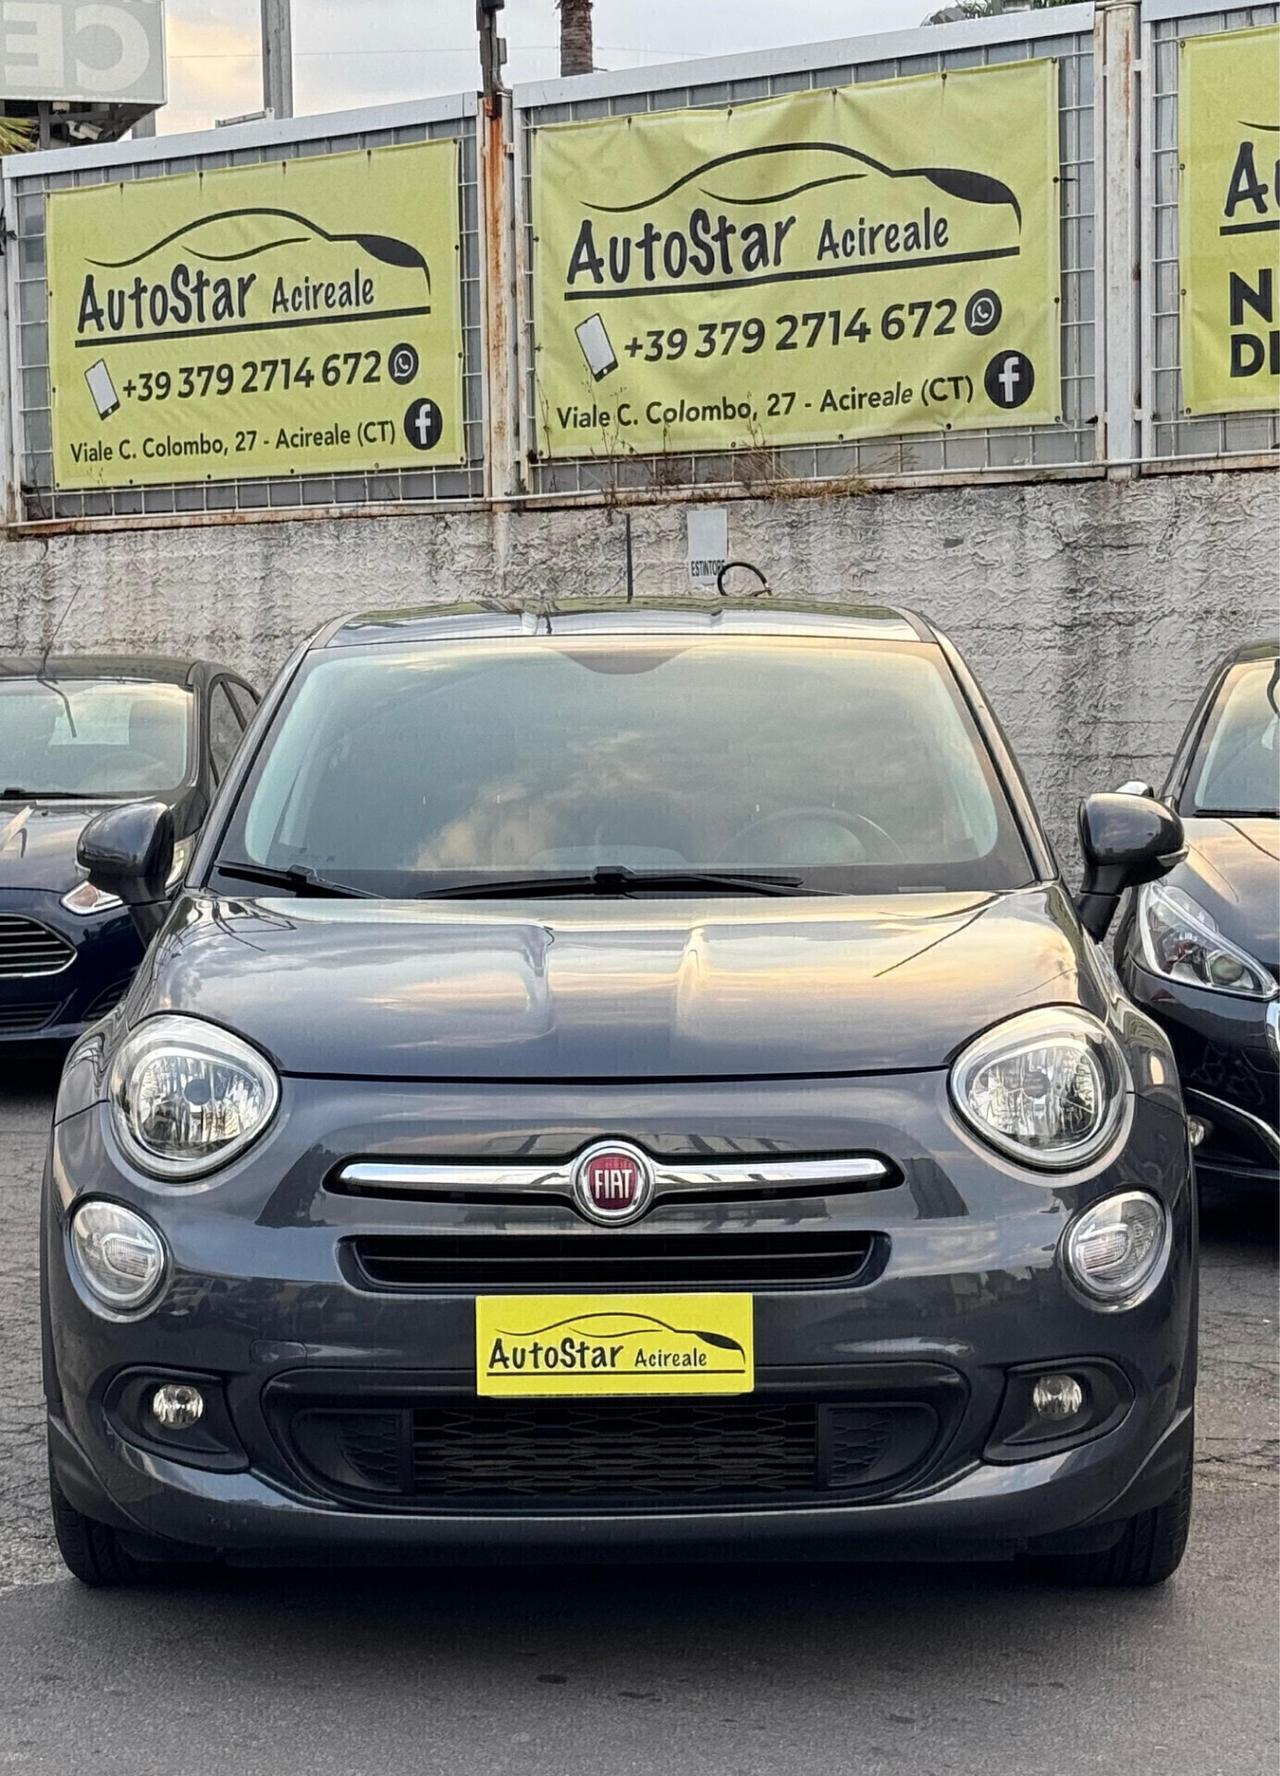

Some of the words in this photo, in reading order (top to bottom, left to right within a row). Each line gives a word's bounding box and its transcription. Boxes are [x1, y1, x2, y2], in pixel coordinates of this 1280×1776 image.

[1224, 141, 1280, 217] A
[566, 208, 797, 284] AutoStar
[816, 207, 950, 261] Acireale
[77, 263, 257, 334] AutoStar
[271, 268, 375, 314] Acireale
[624, 328, 688, 362] +39
[694, 317, 766, 358] 379
[774, 306, 871, 352] 2714
[880, 297, 957, 341] 672
[122, 371, 172, 402] +39
[177, 366, 235, 398] 379
[240, 356, 316, 394] 2714
[322, 350, 382, 387] 672
[556, 402, 611, 430] Viale
[616, 405, 640, 427] C.
[645, 396, 759, 427] Colombo,
[766, 393, 796, 415] 27
[820, 382, 914, 412] Acireale
[920, 375, 974, 407] (CT)
[70, 440, 114, 464] Viale
[118, 442, 138, 461] C.
[142, 434, 229, 459] Colombo,
[234, 430, 258, 453] 27
[275, 423, 352, 450] Acireale
[357, 419, 397, 447] (CT)
[594, 1169, 633, 1200] FIAT
[488, 1337, 625, 1369] AutoStar
[634, 1347, 708, 1368] Acireale
